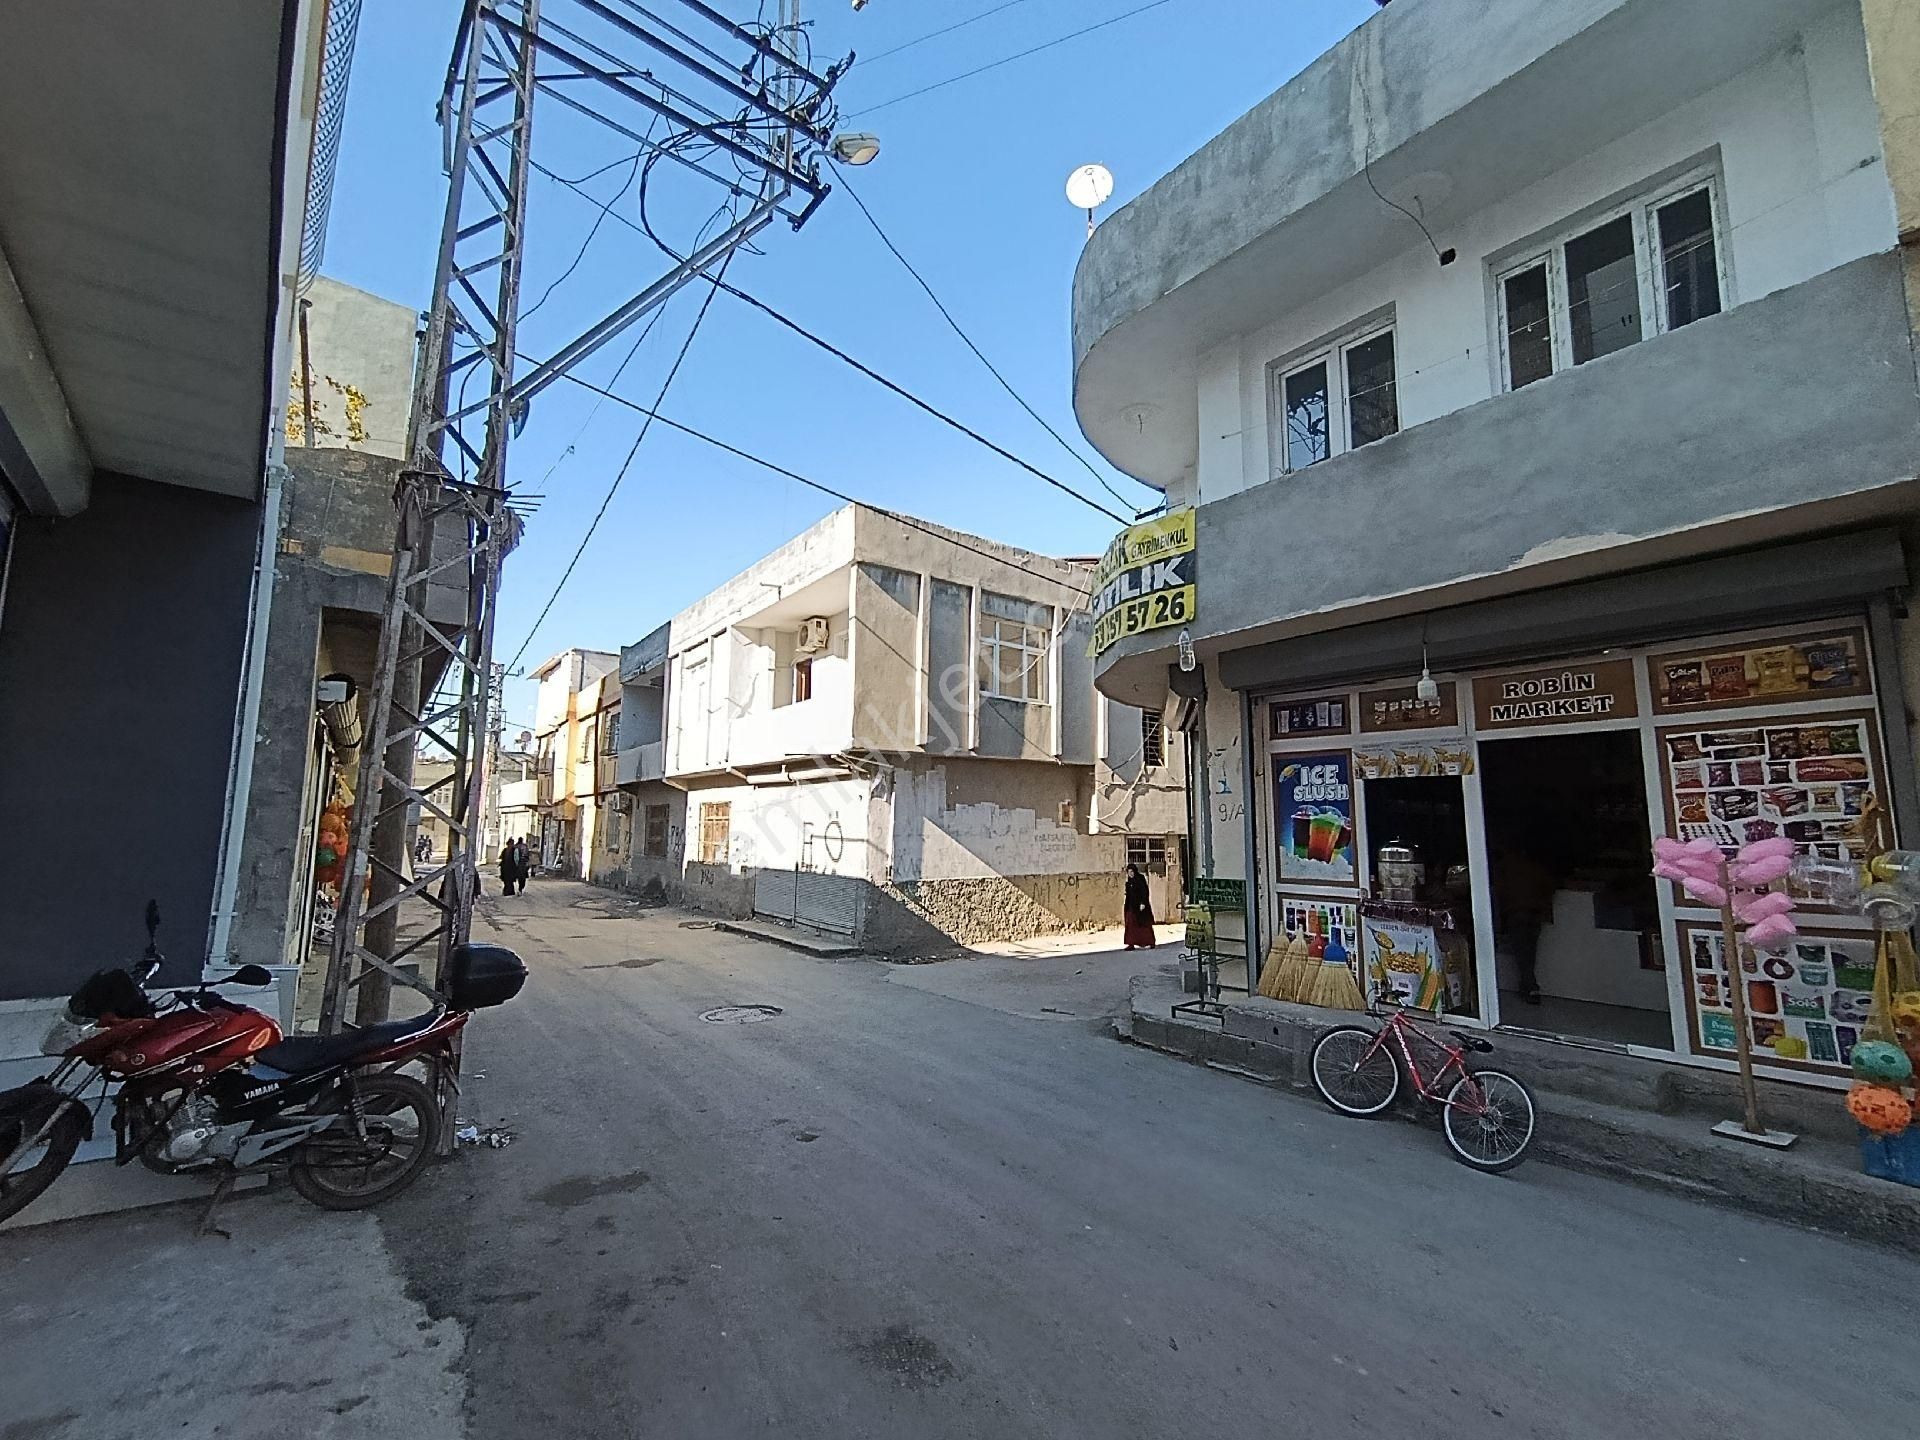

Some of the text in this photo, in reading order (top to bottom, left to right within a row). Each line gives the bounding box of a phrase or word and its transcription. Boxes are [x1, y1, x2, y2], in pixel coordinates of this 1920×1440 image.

[1127, 600, 1150, 632] 57
[1155, 591, 1185, 624] 26
[1502, 671, 1595, 699] ROBİN
[1490, 694, 1614, 721] MARKET
[1300, 764, 1339, 787] ICE
[1293, 783, 1350, 802] SLUSH
[244, 1082, 279, 1100] YAMAHA
